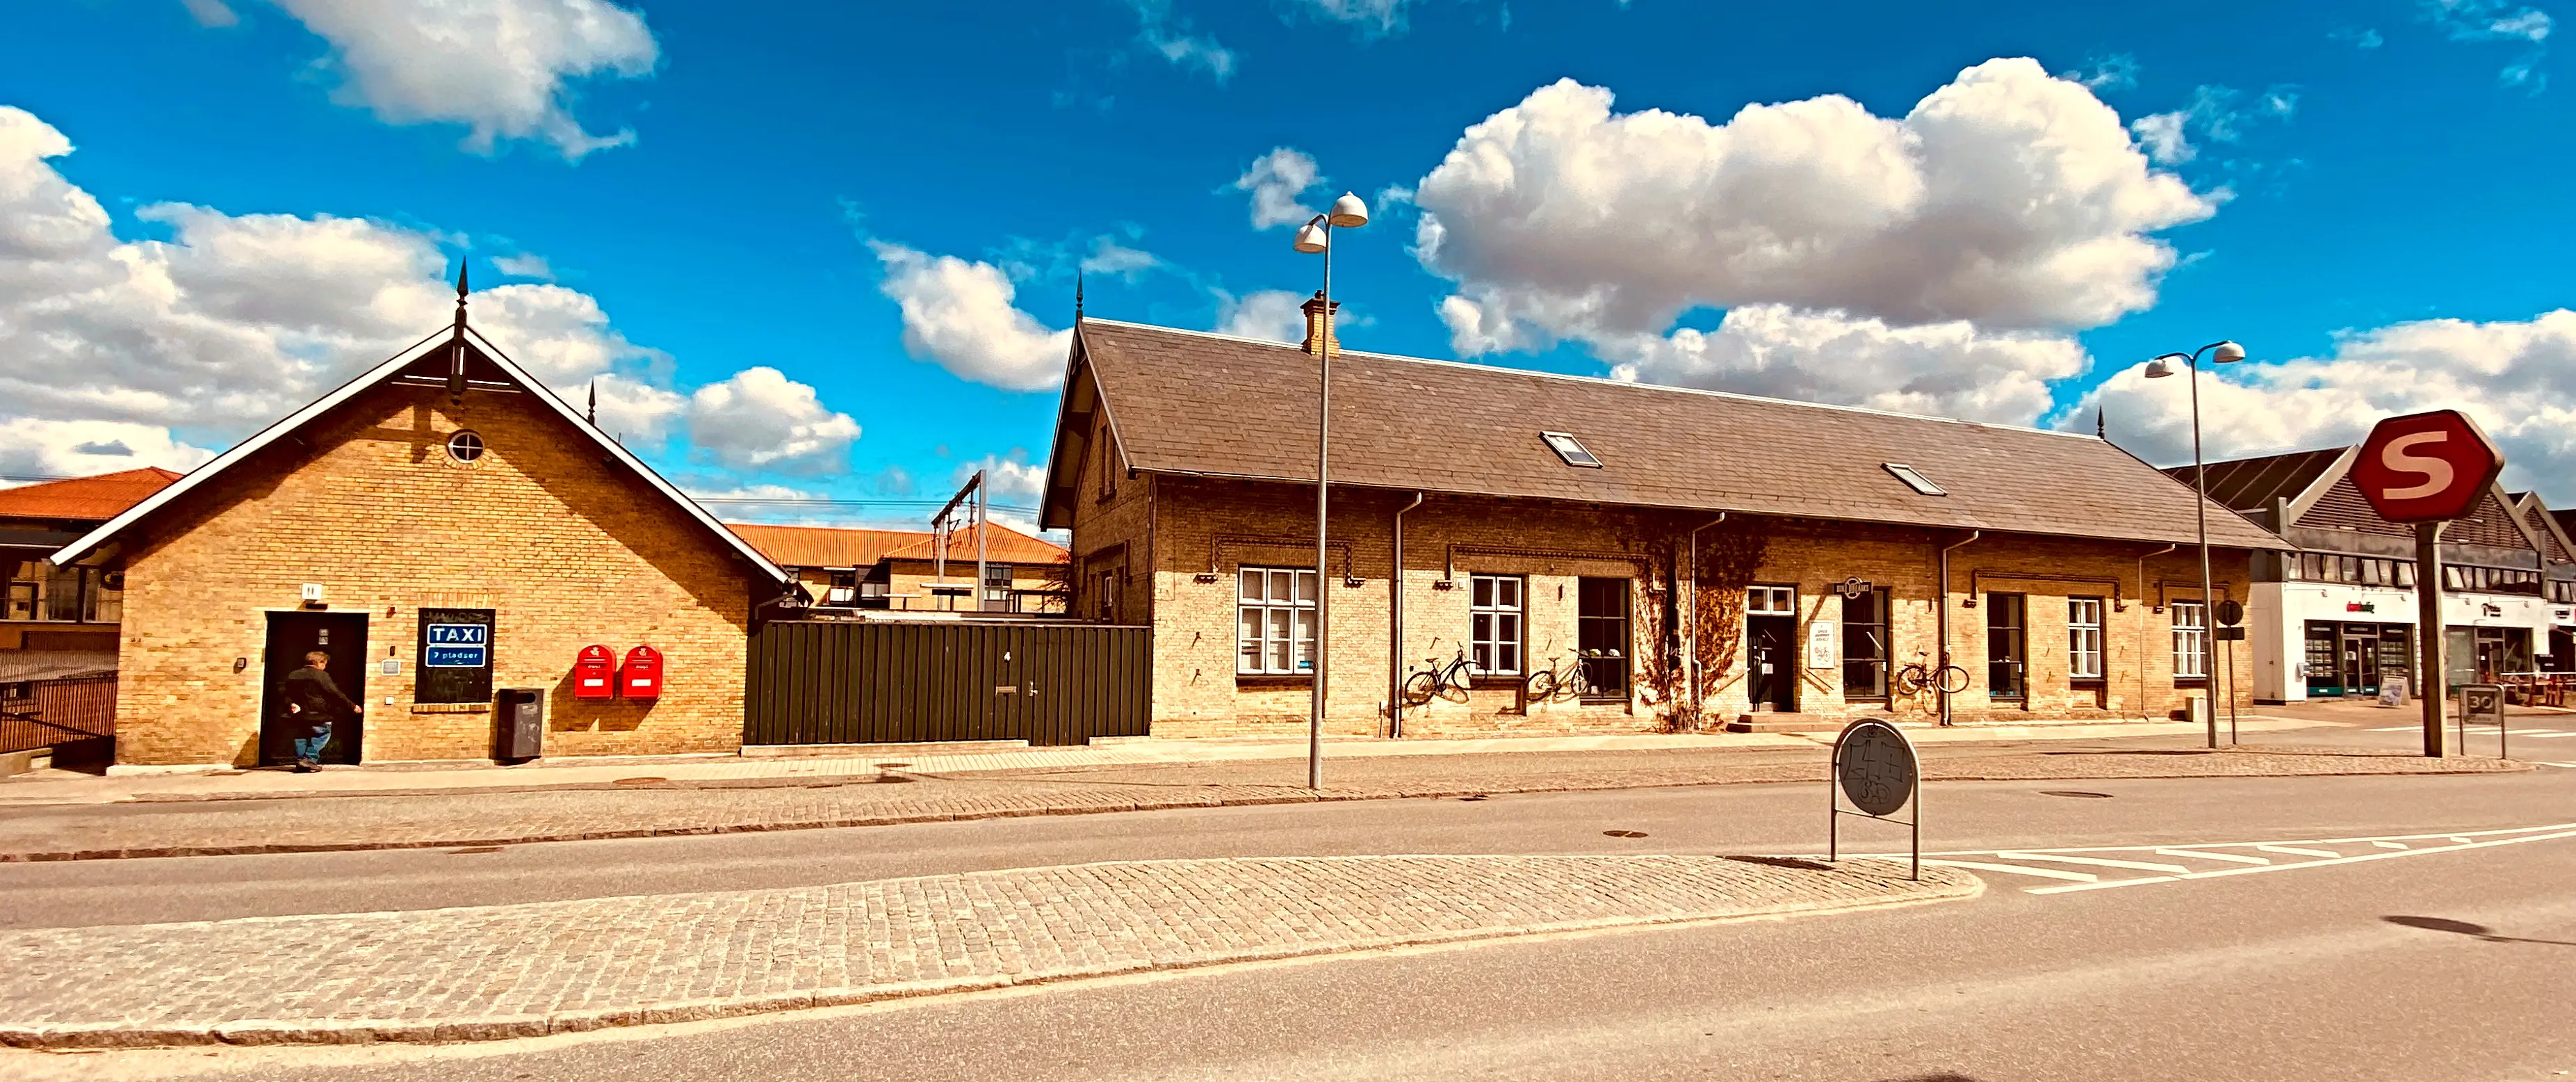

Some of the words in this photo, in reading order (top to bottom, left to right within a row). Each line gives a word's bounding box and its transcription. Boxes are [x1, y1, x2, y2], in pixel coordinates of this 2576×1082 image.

[2381, 430, 2454, 500] S
[432, 627, 482, 642] TAXI
[442, 652, 479, 660] pladser
[1004, 651, 1011, 661] 4
[2468, 695, 2494, 709] 30
